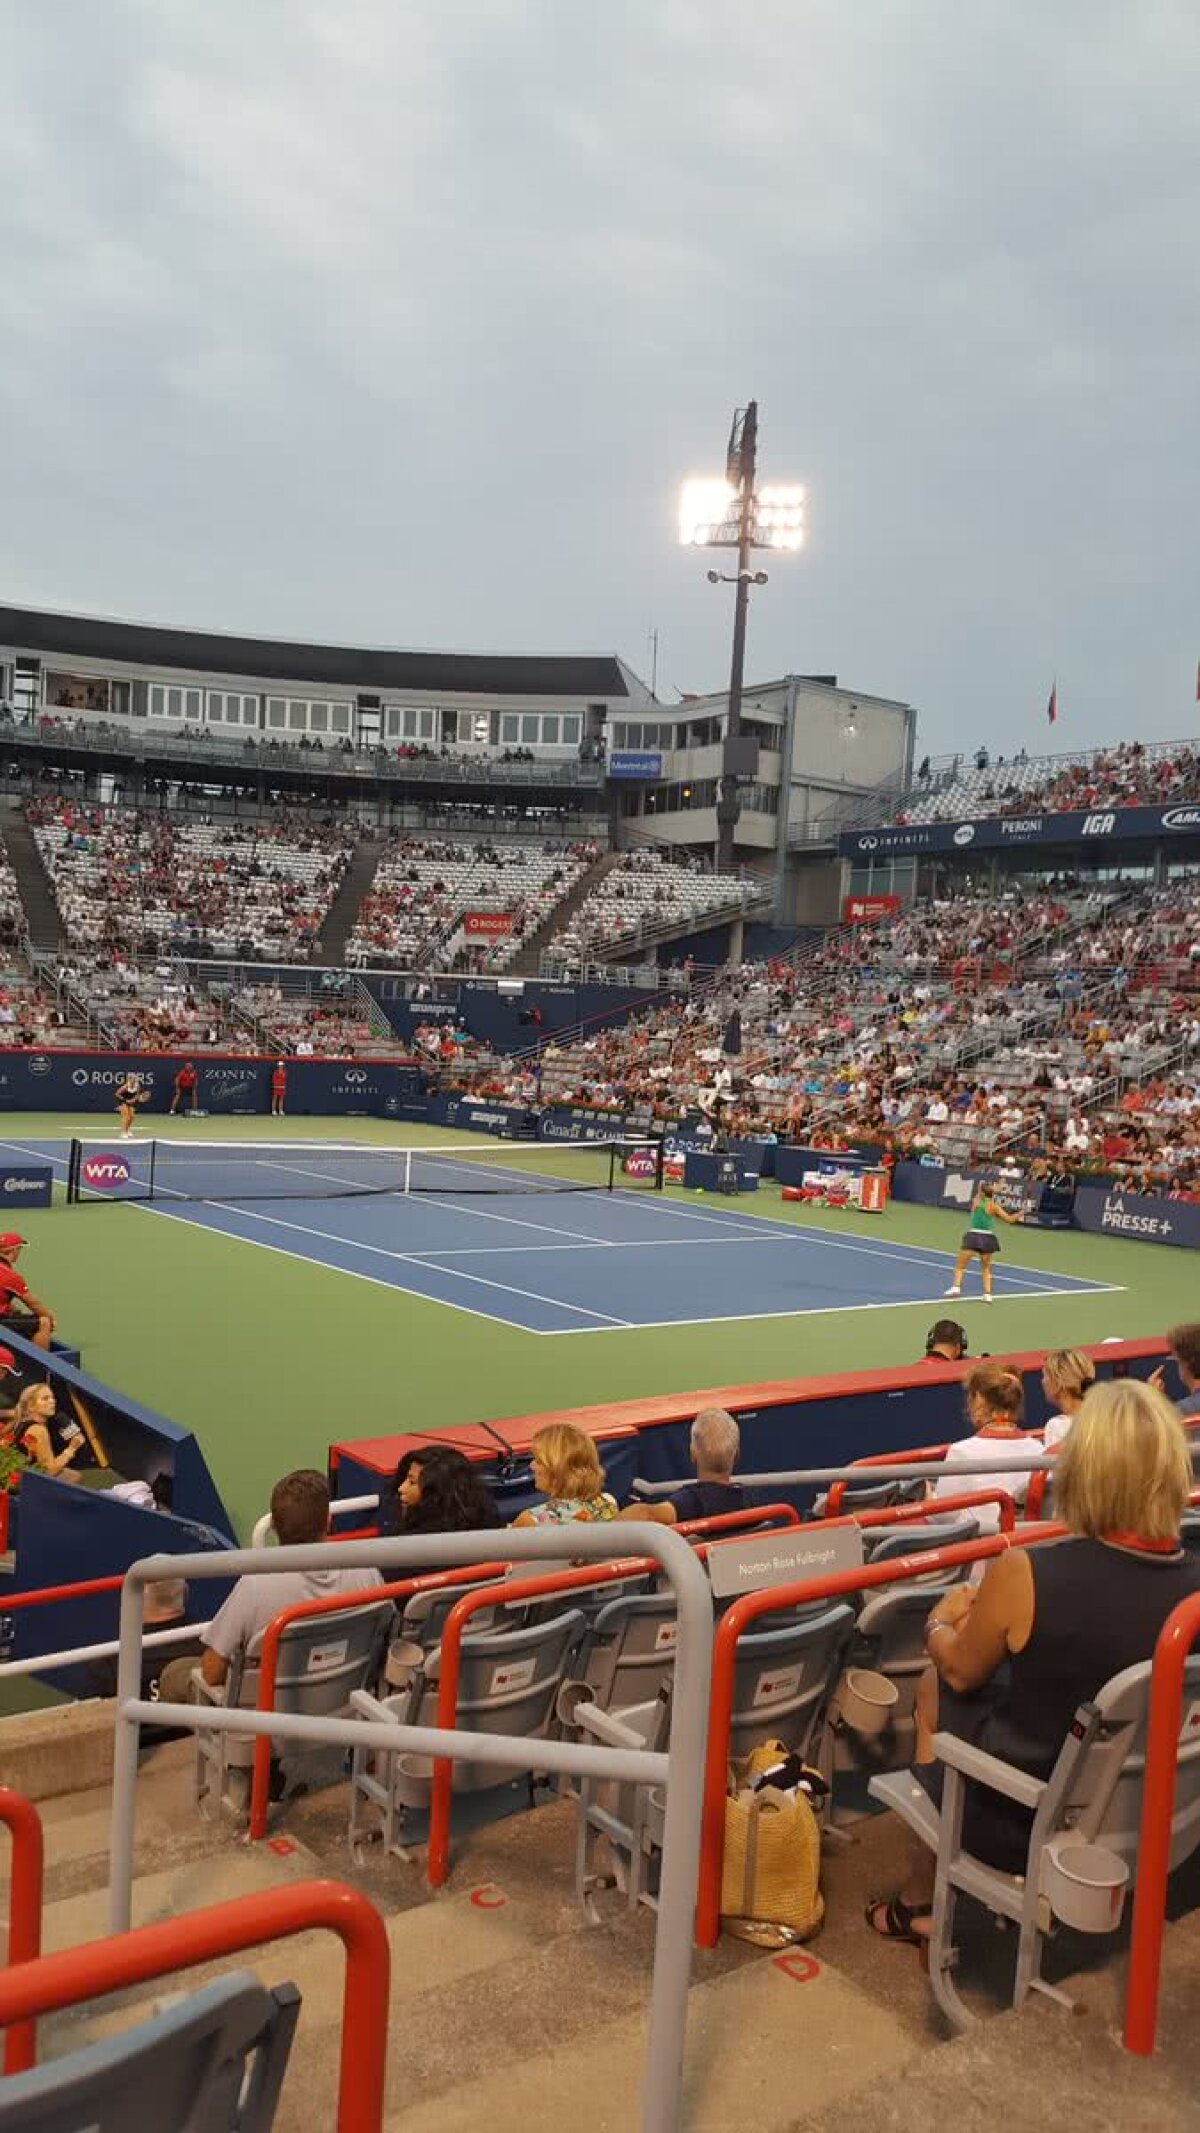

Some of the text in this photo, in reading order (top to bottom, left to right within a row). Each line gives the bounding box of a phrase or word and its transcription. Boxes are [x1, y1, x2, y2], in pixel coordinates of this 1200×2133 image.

[1002, 819, 1042, 833] PERONI
[1081, 814, 1116, 834] IGA
[205, 1069, 257, 1079] ZONIN
[331, 1086, 378, 1094] INFINITI
[86, 1164, 129, 1178] WTA
[627, 1160, 654, 1171] WTA
[1105, 1196, 1124, 1212] LA
[739, 1549, 836, 1576] Norton Rose Fulbright
[470, 1887, 507, 1910] C
[772, 1955, 821, 1983] D
